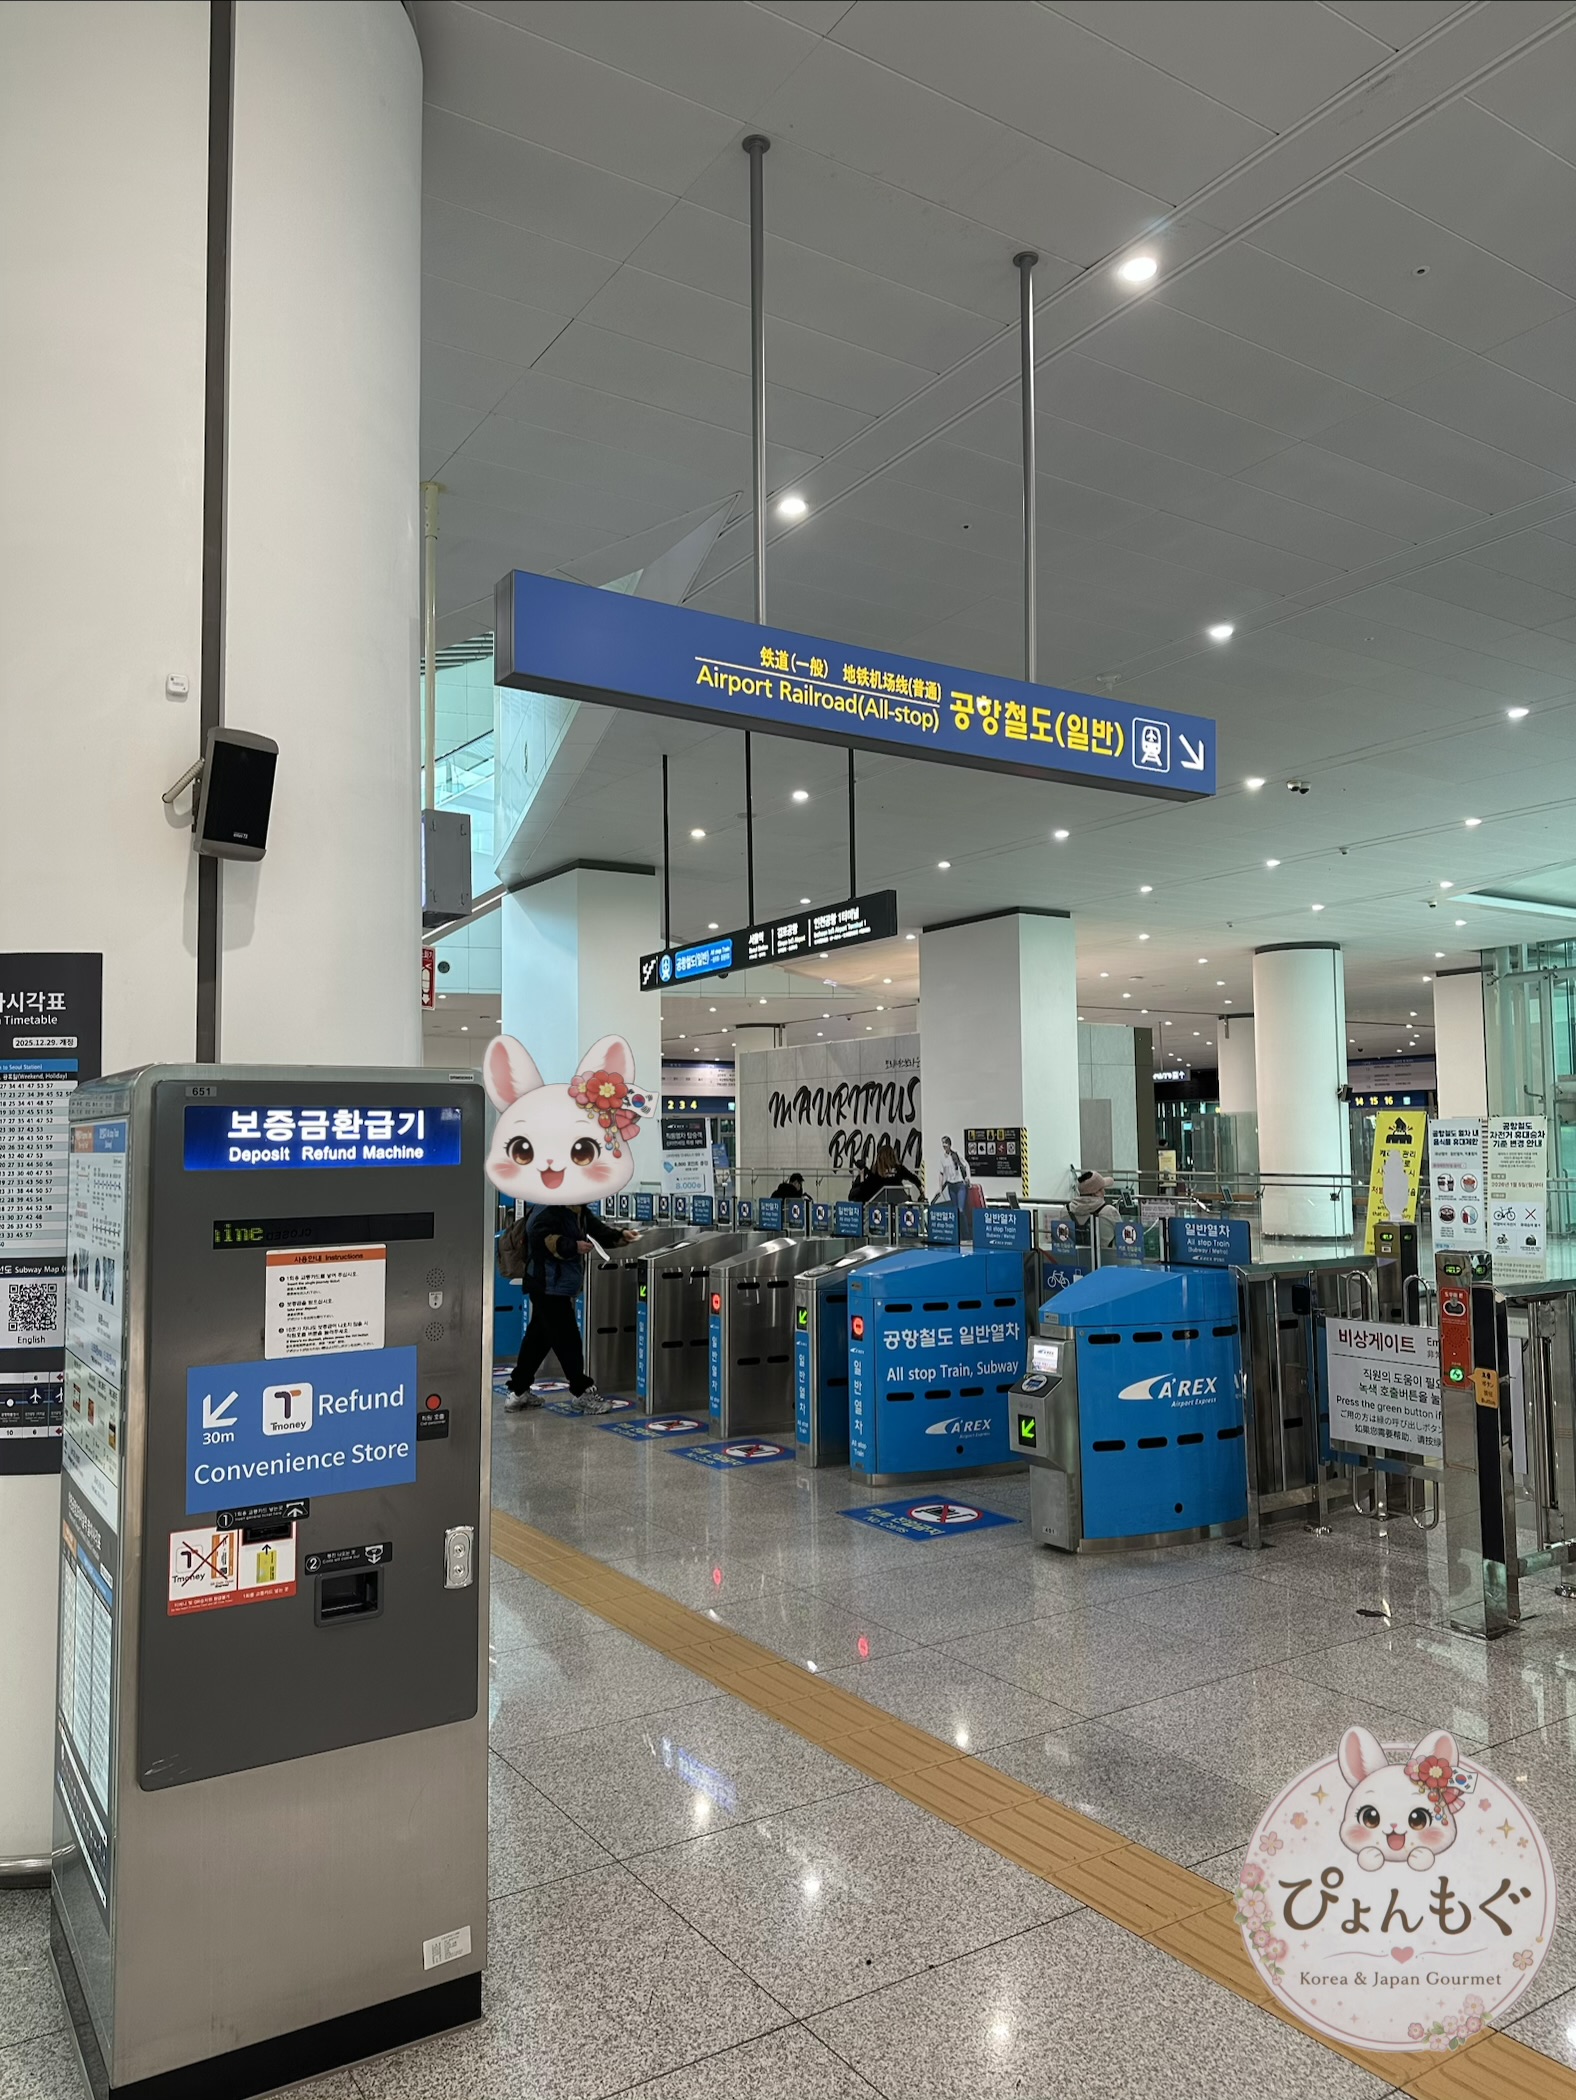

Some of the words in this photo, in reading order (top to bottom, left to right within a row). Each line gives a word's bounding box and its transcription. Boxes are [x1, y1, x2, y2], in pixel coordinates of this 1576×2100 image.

[760, 645, 828, 680] 鉄道(一般)
[842, 663, 942, 701] 地铁机场线(普通)
[696, 663, 773, 699] Airport
[780, 682, 940, 734] Railroad(All-stop)
[950, 691, 1125, 758] 공항철도(일반)
[813, 912, 837, 930] 인천공항
[676, 950, 709, 971] 공항철도(일반)
[4, 1014, 58, 1025] Timetable
[15, 1039, 58, 1047] 2025.12.29.
[192, 1086, 211, 1096] 651
[667, 1099, 675, 1110] 2
[679, 1100, 686, 1110] 3
[690, 1100, 698, 1110] 4
[768, 1075, 920, 1129] MAURITIUS
[1354, 1097, 1364, 1107] 14
[1369, 1096, 1379, 1106] 15
[1384, 1095, 1394, 1106] 16
[227, 1109, 425, 1142] 보증금환급기
[1503, 1122, 1532, 1130] 공항철도
[1490, 1130, 1512, 1139] 자전거
[1515, 1130, 1545, 1139] 휴대승차
[1493, 1140, 1507, 1148] 기준
[1510, 1140, 1524, 1148] 변경
[229, 1146, 290, 1164] Deposit
[302, 1145, 357, 1161] Refund
[363, 1144, 424, 1160] Machine
[761, 1202, 779, 1211] 일반열차
[838, 1206, 859, 1216] 일반열차
[930, 1211, 955, 1221] 일반열차
[984, 1213, 1016, 1224] 일반열차
[1185, 1223, 1230, 1238] 일반열차
[1198, 1239, 1212, 1247] stop
[325, 1253, 364, 1261] Instructions
[15, 1266, 42, 1274] Subway
[44, 1265, 60, 1273] Map
[17, 1336, 46, 1344] English
[883, 1328, 953, 1350] 공항철도
[959, 1322, 1020, 1344] 일반열차
[1339, 1329, 1416, 1354] 비상게이트
[886, 1367, 904, 1381] All
[908, 1366, 936, 1382] stop
[940, 1364, 973, 1378] Train,
[977, 1360, 1019, 1377] Subway
[1363, 1368, 1391, 1382] 직원의
[1394, 1373, 1422, 1388] 도움이
[1158, 1376, 1218, 1399] A'REX
[1360, 1382, 1377, 1396] 녹색
[1380, 1385, 1428, 1403] 호출버튼을
[319, 1383, 405, 1416] Refund
[854, 1360, 863, 1436] 일반열차
[1171, 1399, 1194, 1408] Airport
[1194, 1397, 1217, 1406] Express
[1337, 1395, 1359, 1407] Press
[1361, 1400, 1375, 1409] the
[1377, 1403, 1402, 1413] green
[1405, 1407, 1433, 1418] button
[270, 1420, 307, 1432] Tmoney
[202, 1431, 235, 1445] 30m
[854, 1448, 864, 1457] Train
[194, 1449, 345, 1485] Convenience
[351, 1442, 409, 1464] Store
[223, 1514, 228, 1526] 1
[863, 1515, 880, 1524] No
[880, 1521, 908, 1534] Carts
[310, 1557, 317, 1570] 2
